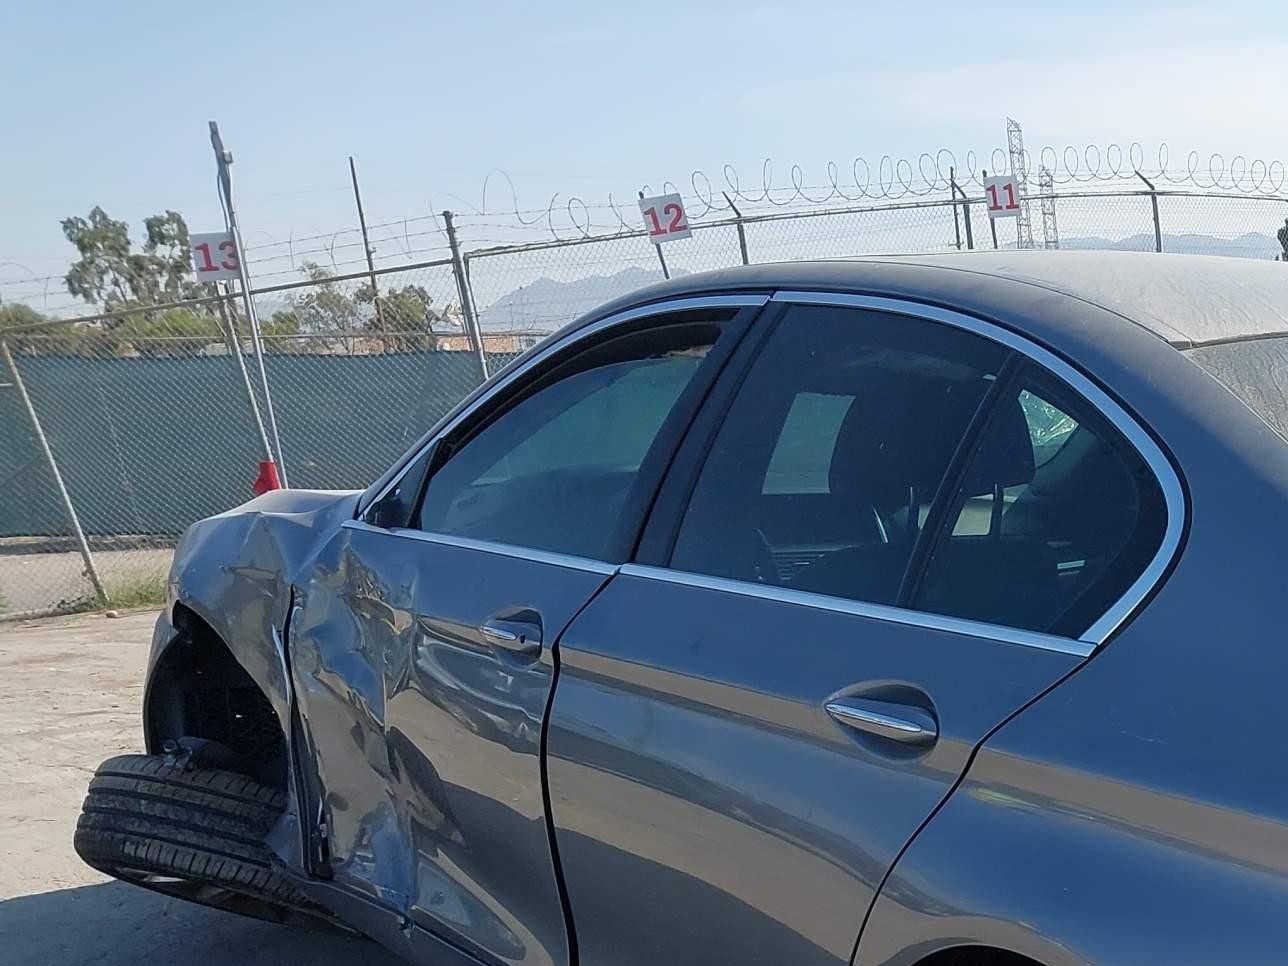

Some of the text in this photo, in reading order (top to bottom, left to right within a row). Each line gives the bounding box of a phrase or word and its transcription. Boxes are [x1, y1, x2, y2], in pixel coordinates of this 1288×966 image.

[985, 183, 1020, 210] 11
[643, 203, 688, 236] 12
[194, 240, 240, 272] 13
